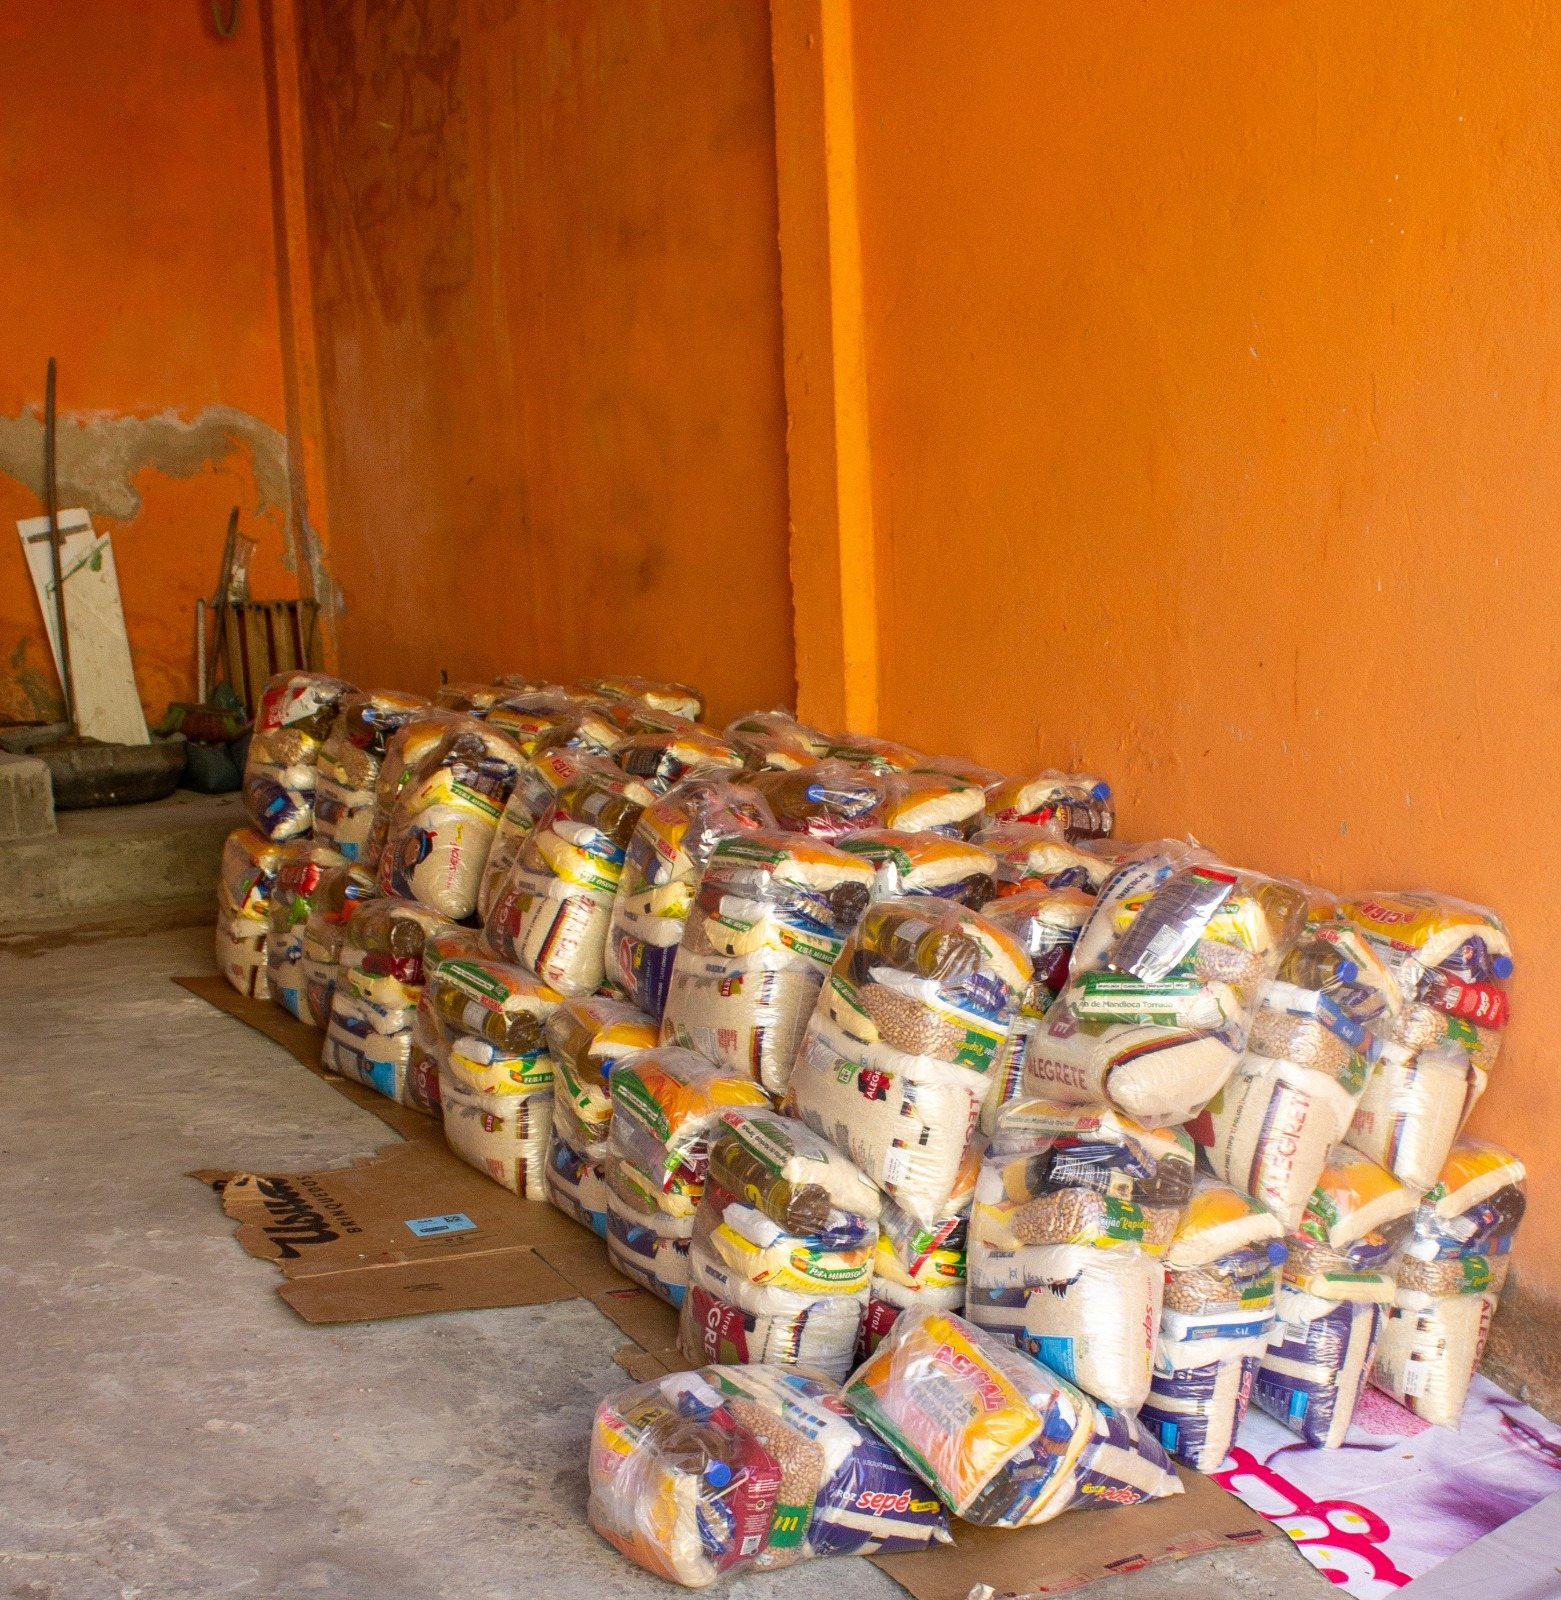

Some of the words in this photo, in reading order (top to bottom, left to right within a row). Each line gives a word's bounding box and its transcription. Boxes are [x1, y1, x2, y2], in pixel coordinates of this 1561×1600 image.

[1102, 999, 1141, 1008] Mandioca
[298, 1175, 363, 1234] BRINQUEDOS
[720, 1310, 735, 1336] Arroz
[871, 1304, 885, 1332] Arroz
[855, 1487, 913, 1515] sepé
